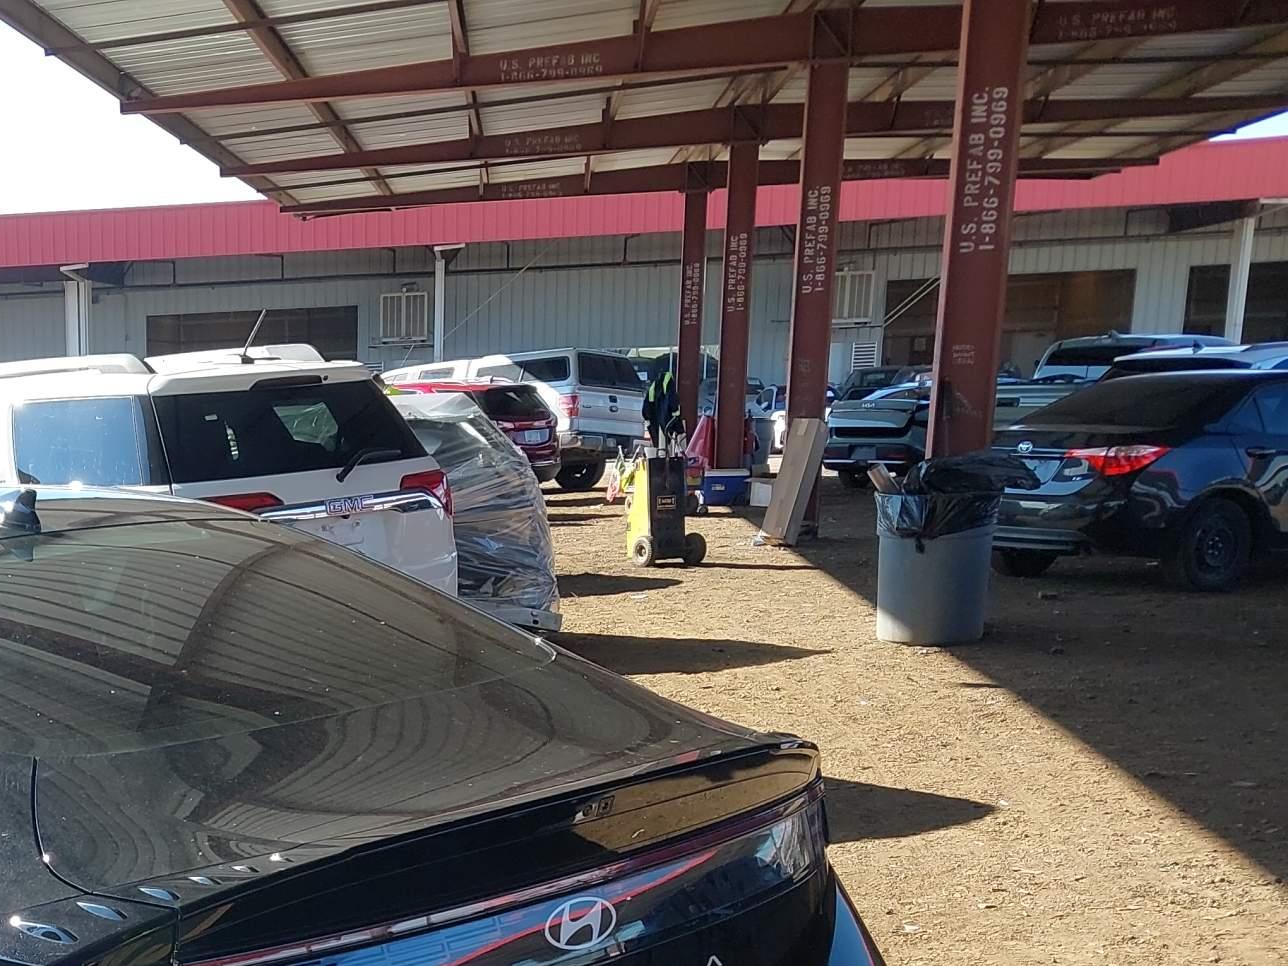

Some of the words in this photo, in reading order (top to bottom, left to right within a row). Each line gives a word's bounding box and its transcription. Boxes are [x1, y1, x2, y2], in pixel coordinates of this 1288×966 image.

[970, 87, 989, 123] INC.
[963, 132, 985, 207] PREFAB
[979, 86, 1009, 250] 1-866-799-0969
[807, 186, 820, 210] INC.
[804, 215, 817, 264] PREFAB
[814, 185, 832, 292] 1-866-799-0969
[960, 217, 979, 253] U.S.
[728, 254, 738, 290] PREFAB
[802, 270, 814, 294] U.S.
[325, 495, 374, 515] GMC
